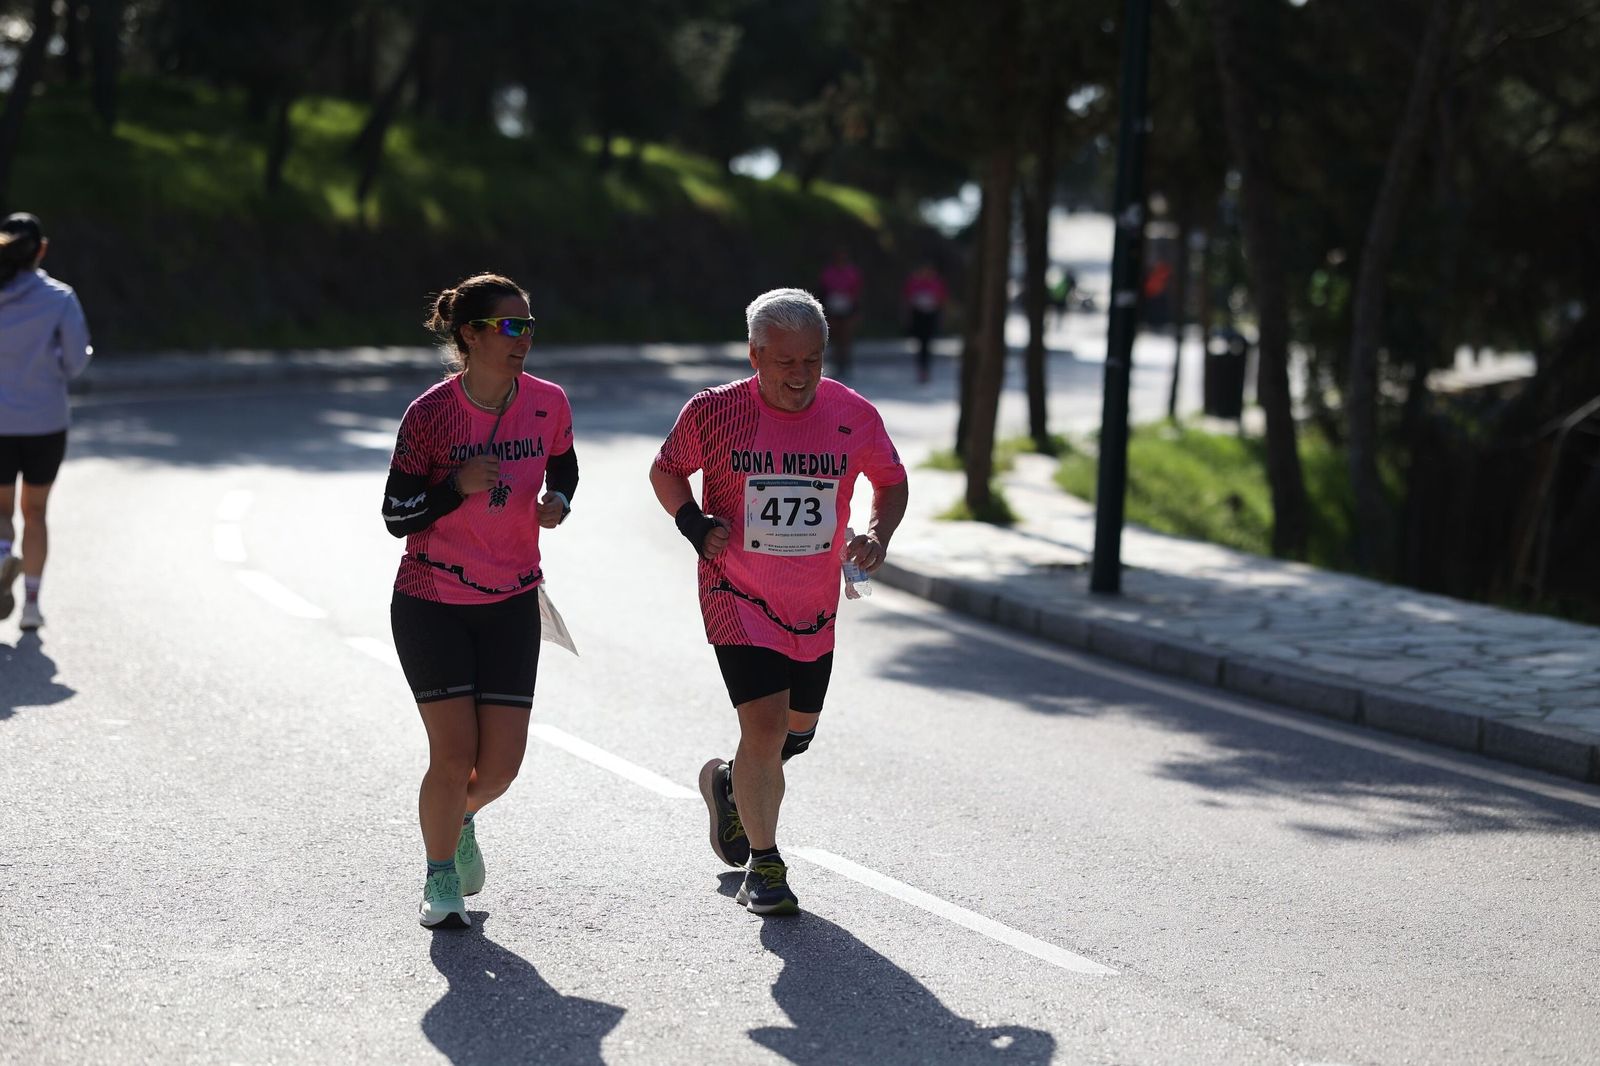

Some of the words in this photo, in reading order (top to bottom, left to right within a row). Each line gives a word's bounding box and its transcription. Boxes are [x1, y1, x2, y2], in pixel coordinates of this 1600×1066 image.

[449, 442, 484, 462] DONA
[491, 436, 544, 461] MEDULA
[732, 450, 774, 473] DONA
[783, 453, 848, 475] MEDULA
[761, 497, 822, 526] 473
